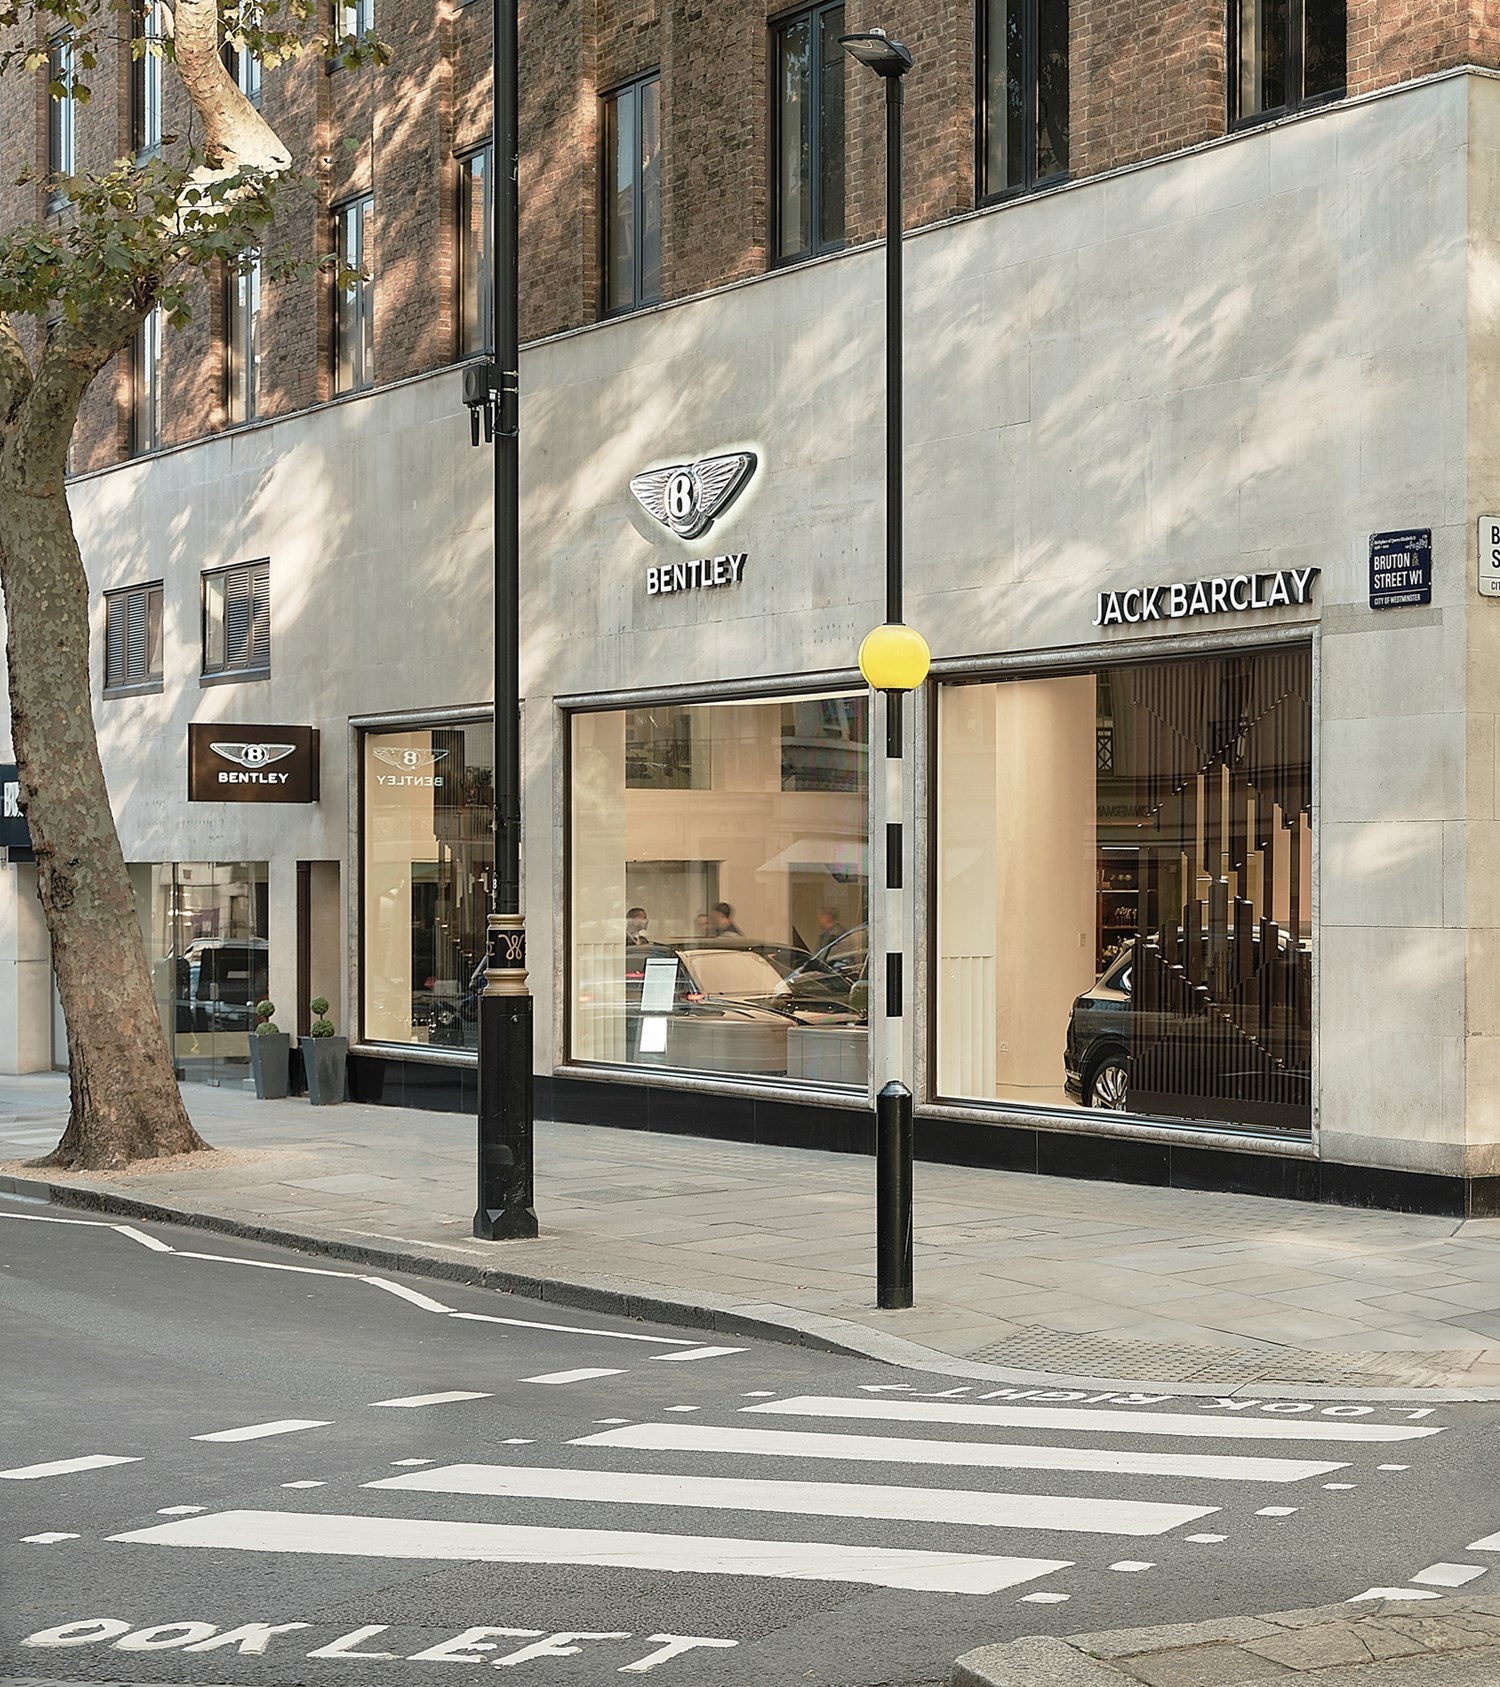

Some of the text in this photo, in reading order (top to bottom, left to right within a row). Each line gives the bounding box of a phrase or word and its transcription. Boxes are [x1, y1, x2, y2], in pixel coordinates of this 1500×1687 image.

[646, 552, 748, 595] BENTLEY
[1374, 552, 1410, 571] BRUTON
[1374, 569, 1422, 589] STREET W1
[1092, 566, 1318, 626] JACK BARCLAY
[1374, 594, 1421, 605] CITY OF WESTMINSTER
[218, 772, 289, 784] BENTLEY
[908, 1386, 1436, 1419] LOOK RIGHT
[20, 1618, 740, 1674] OOK LEFT
